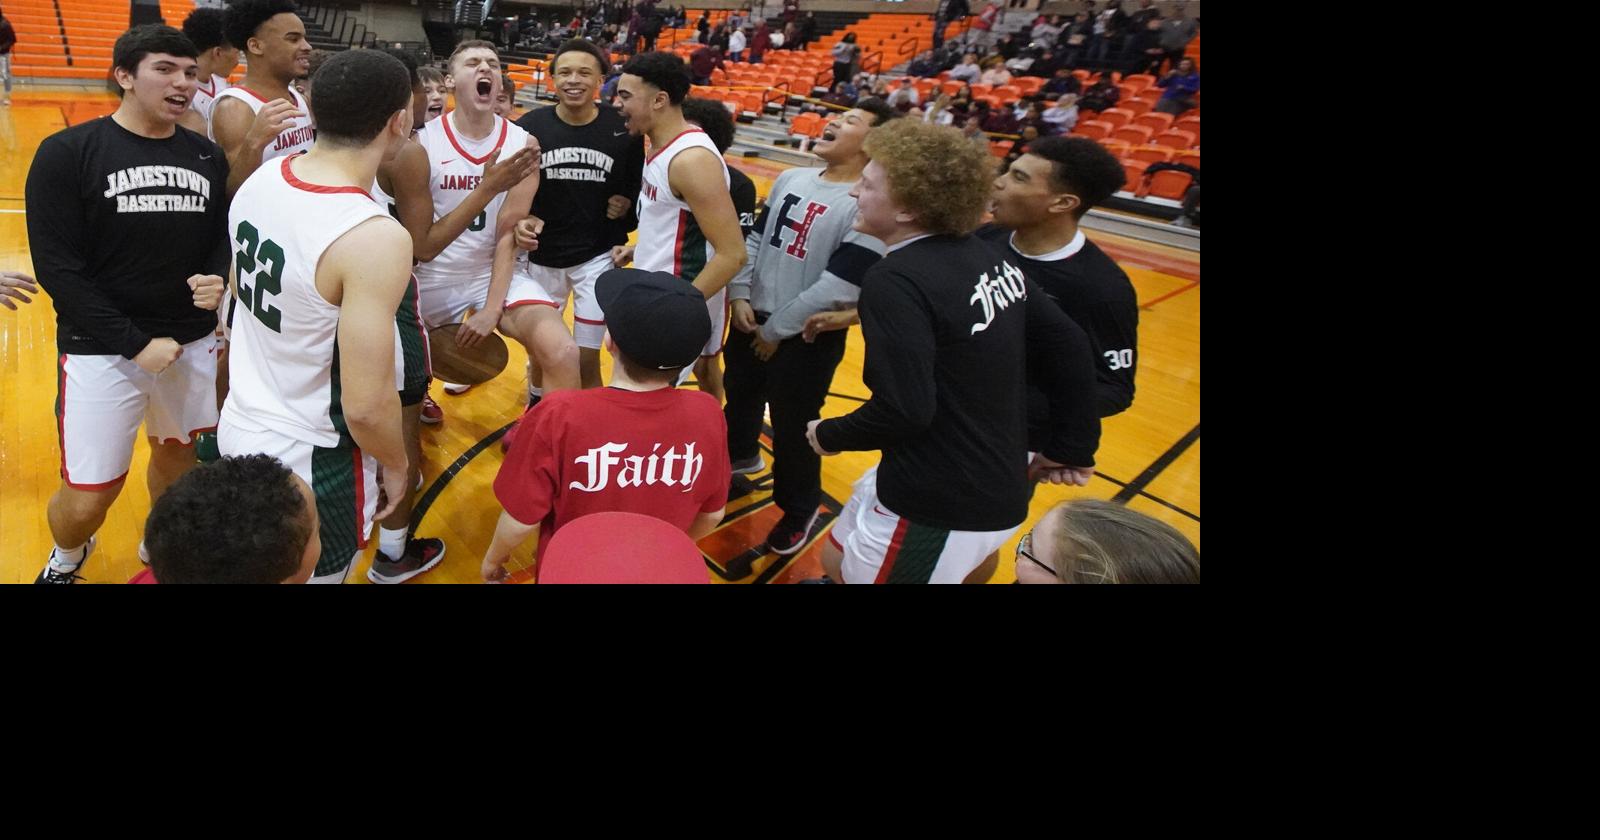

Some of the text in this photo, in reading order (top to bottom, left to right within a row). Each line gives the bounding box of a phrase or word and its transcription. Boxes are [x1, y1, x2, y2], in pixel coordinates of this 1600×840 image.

[540, 147, 615, 174] JAMESTOWN
[104, 165, 211, 200] JAMESTOWN
[440, 174, 484, 190] JAMES
[545, 168, 606, 182] BASKETBALL
[116, 194, 206, 213] BASKETBALL
[235, 220, 286, 334] 22
[1104, 349, 1133, 370] 30
[569, 441, 703, 493] Faith
